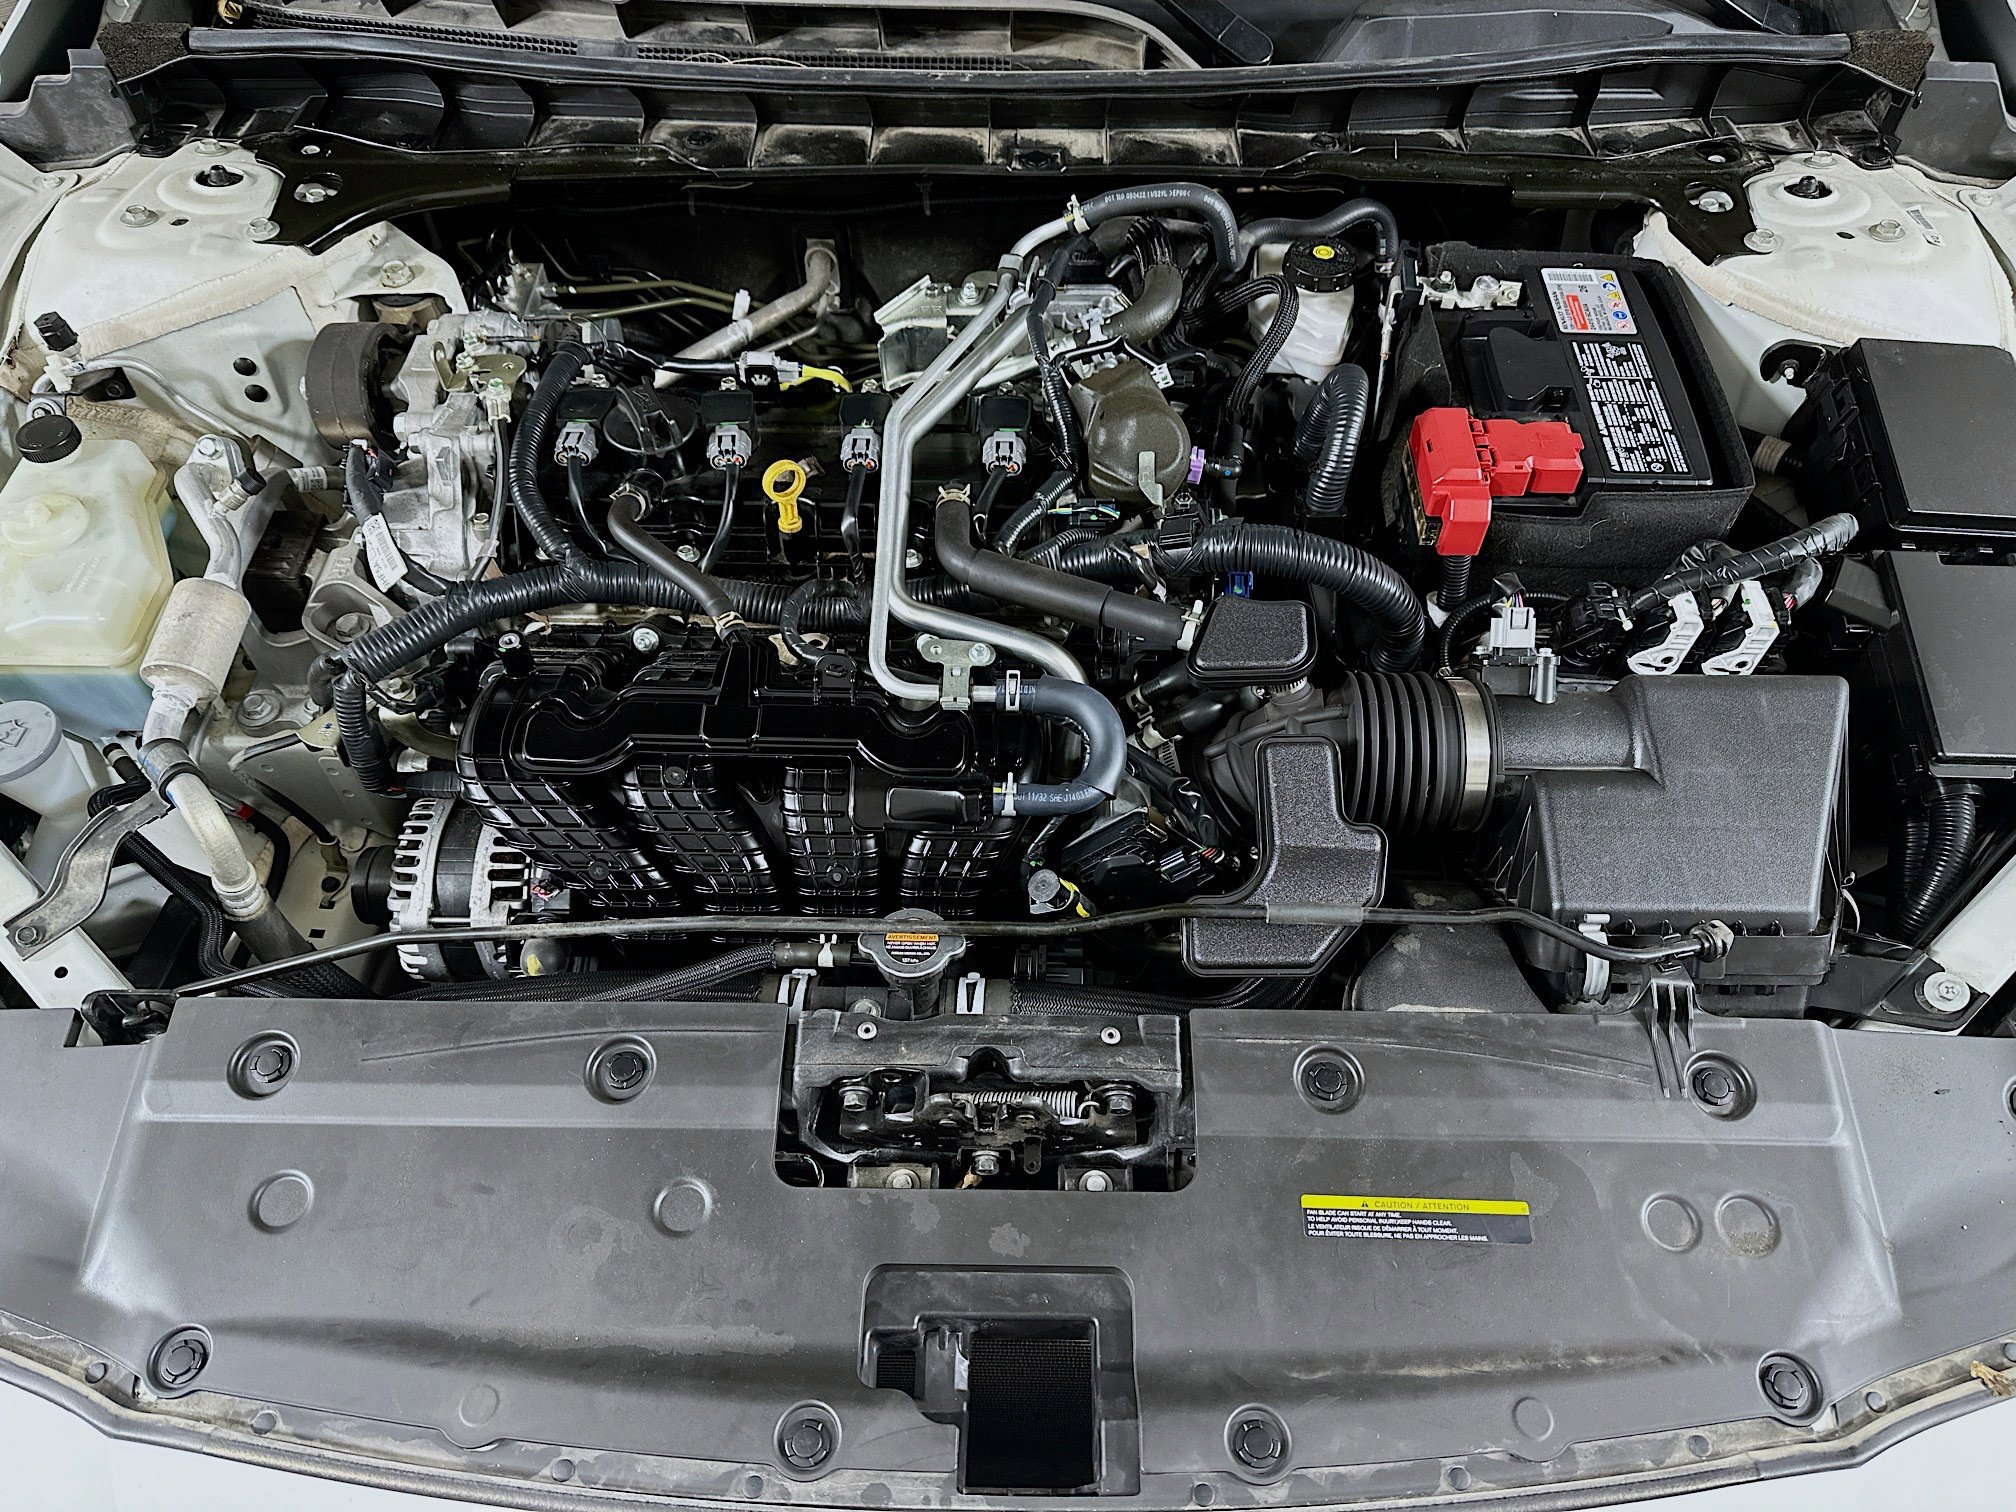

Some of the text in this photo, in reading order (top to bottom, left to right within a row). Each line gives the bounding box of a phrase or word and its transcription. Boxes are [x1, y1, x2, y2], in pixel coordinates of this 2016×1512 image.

[1028, 791, 1047, 802] 11/32
[1374, 1200, 1413, 1209] CAUTION
[1423, 1202, 1470, 1211] ATTENTION
[1382, 1224, 1412, 1232] DÉMARRER
